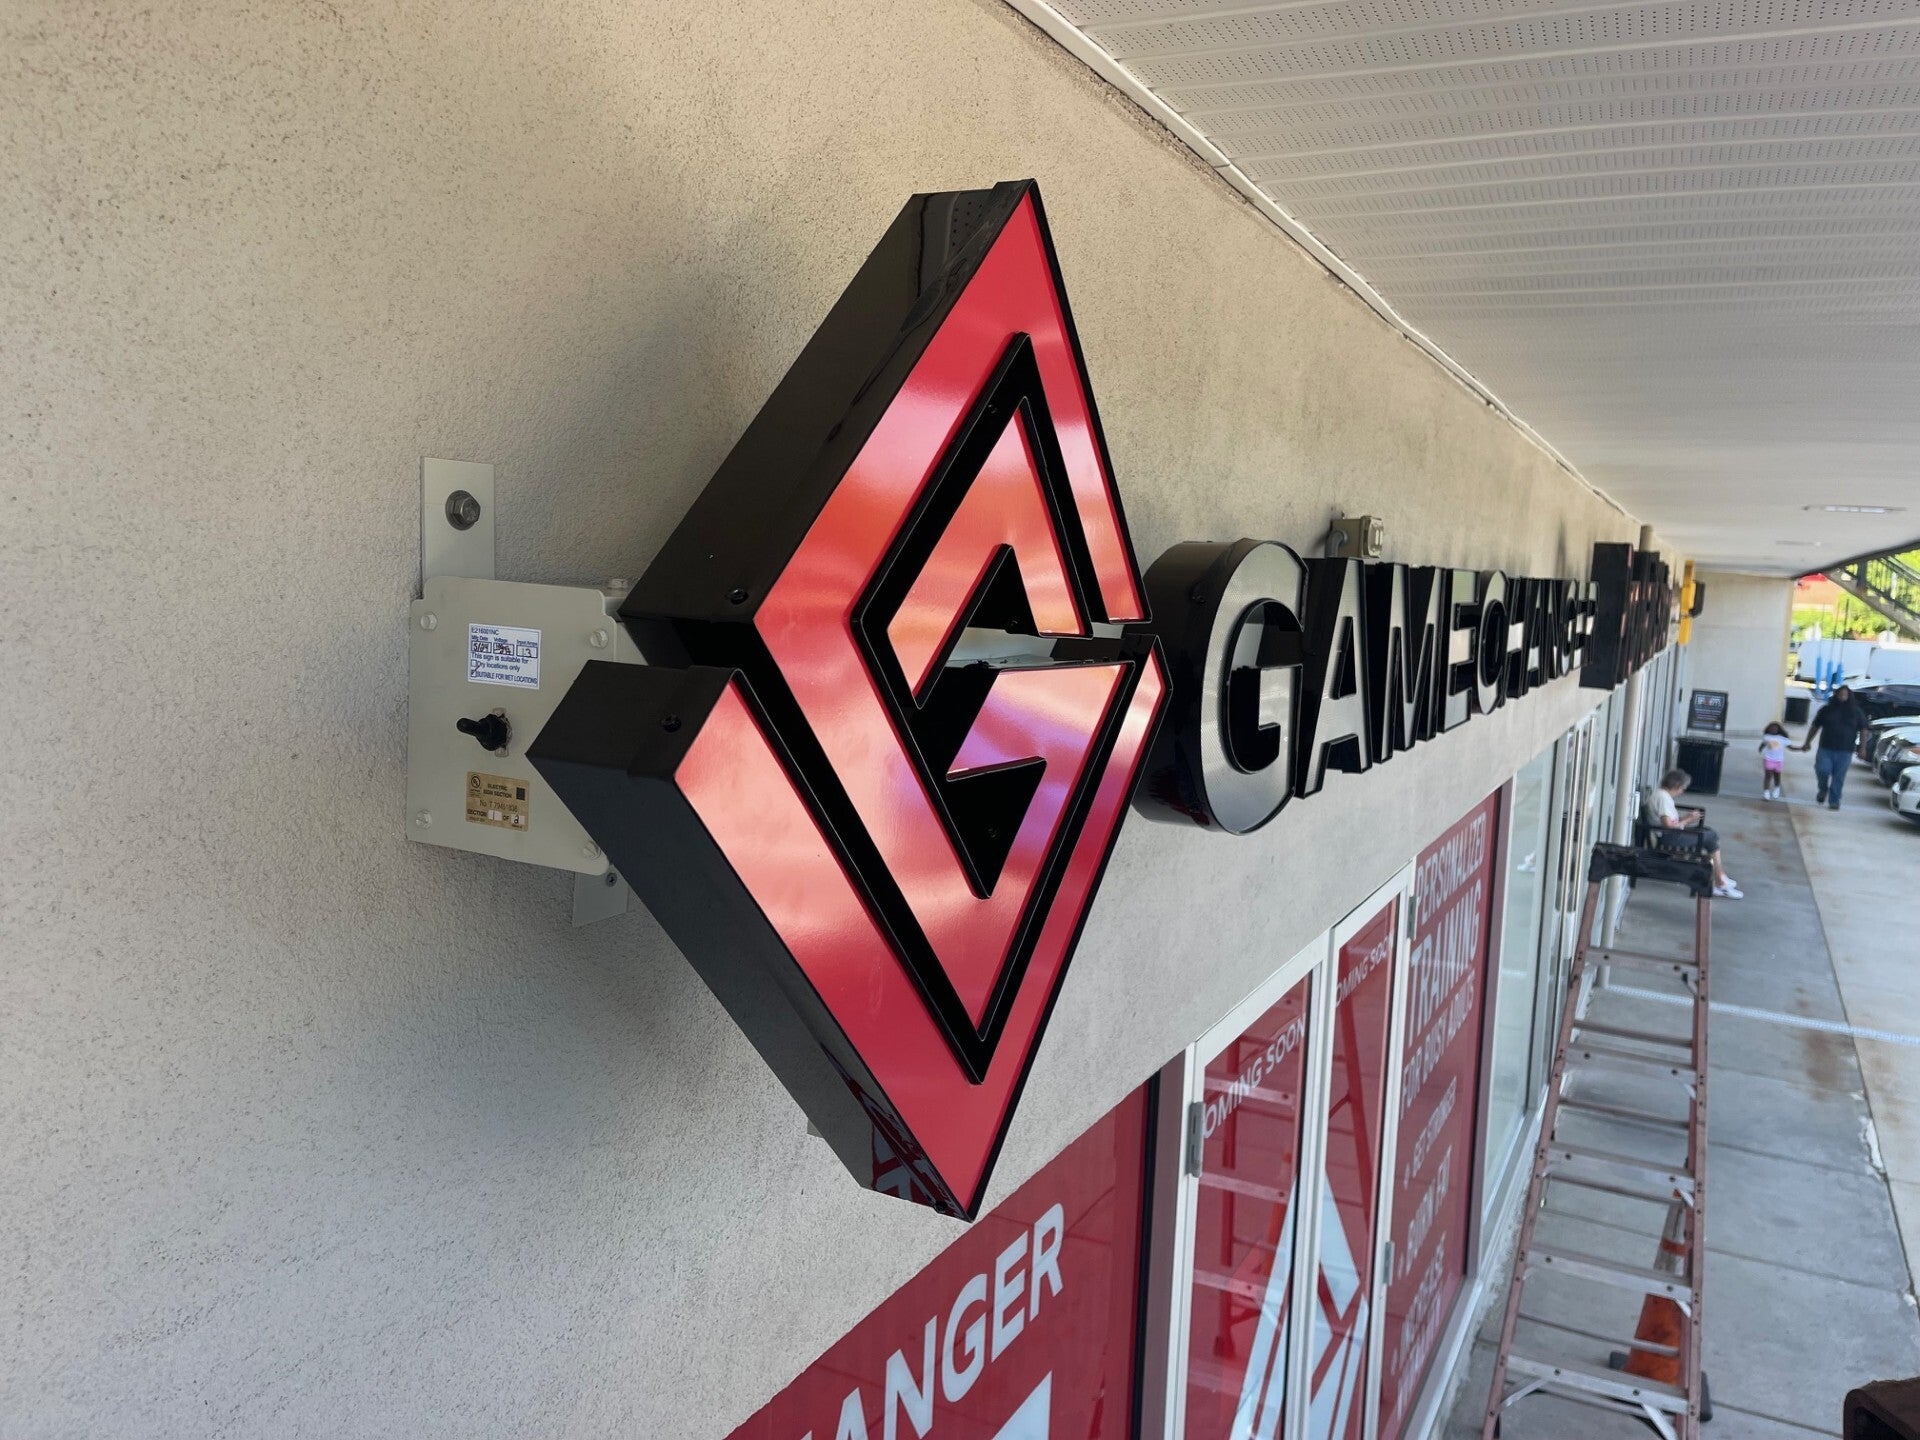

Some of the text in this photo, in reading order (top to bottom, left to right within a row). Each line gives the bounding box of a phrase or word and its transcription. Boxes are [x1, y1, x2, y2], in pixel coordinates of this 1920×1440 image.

[471, 652, 483, 660] This
[483, 654, 494, 662] sign
[476, 660, 521, 672] Dry locations only
[514, 675, 538, 684] LOCATIONS
[1416, 811, 1487, 926] PERSONALIZED
[1336, 956, 1368, 1008] OMING
[1408, 878, 1482, 1049] TRAINING
[1203, 1012, 1306, 1139] OMING SOON
[1400, 1046, 1423, 1122] FOR
